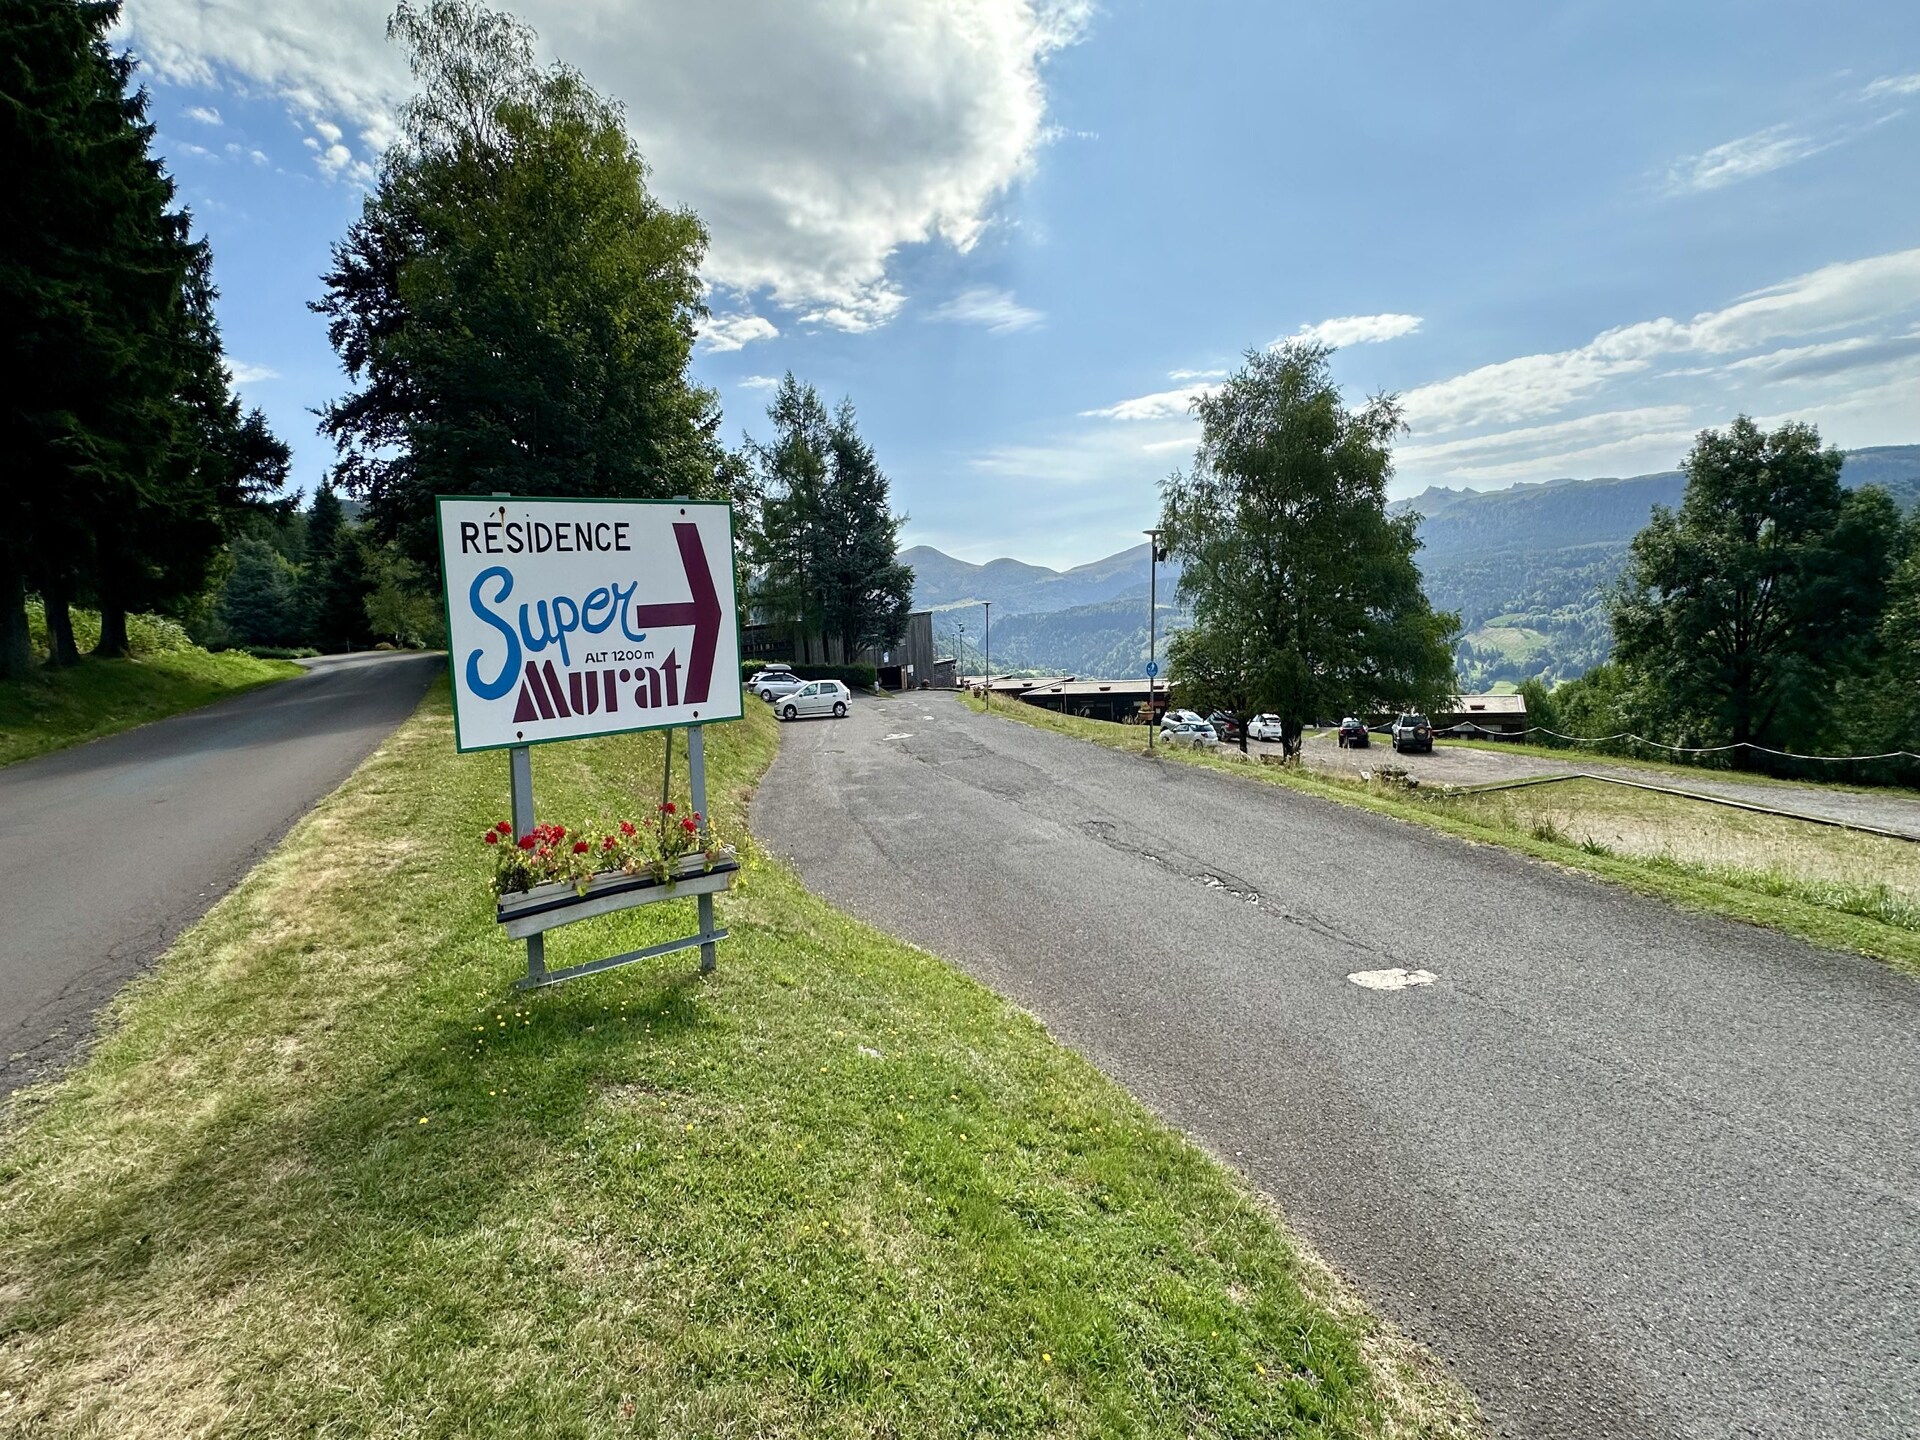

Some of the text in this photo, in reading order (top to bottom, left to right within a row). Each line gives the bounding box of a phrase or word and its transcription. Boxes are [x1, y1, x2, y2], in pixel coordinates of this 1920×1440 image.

[466, 566, 646, 700] Super
[585, 652, 608, 663] ALT
[611, 650, 642, 661] 1200
[512, 647, 681, 723] Murat
